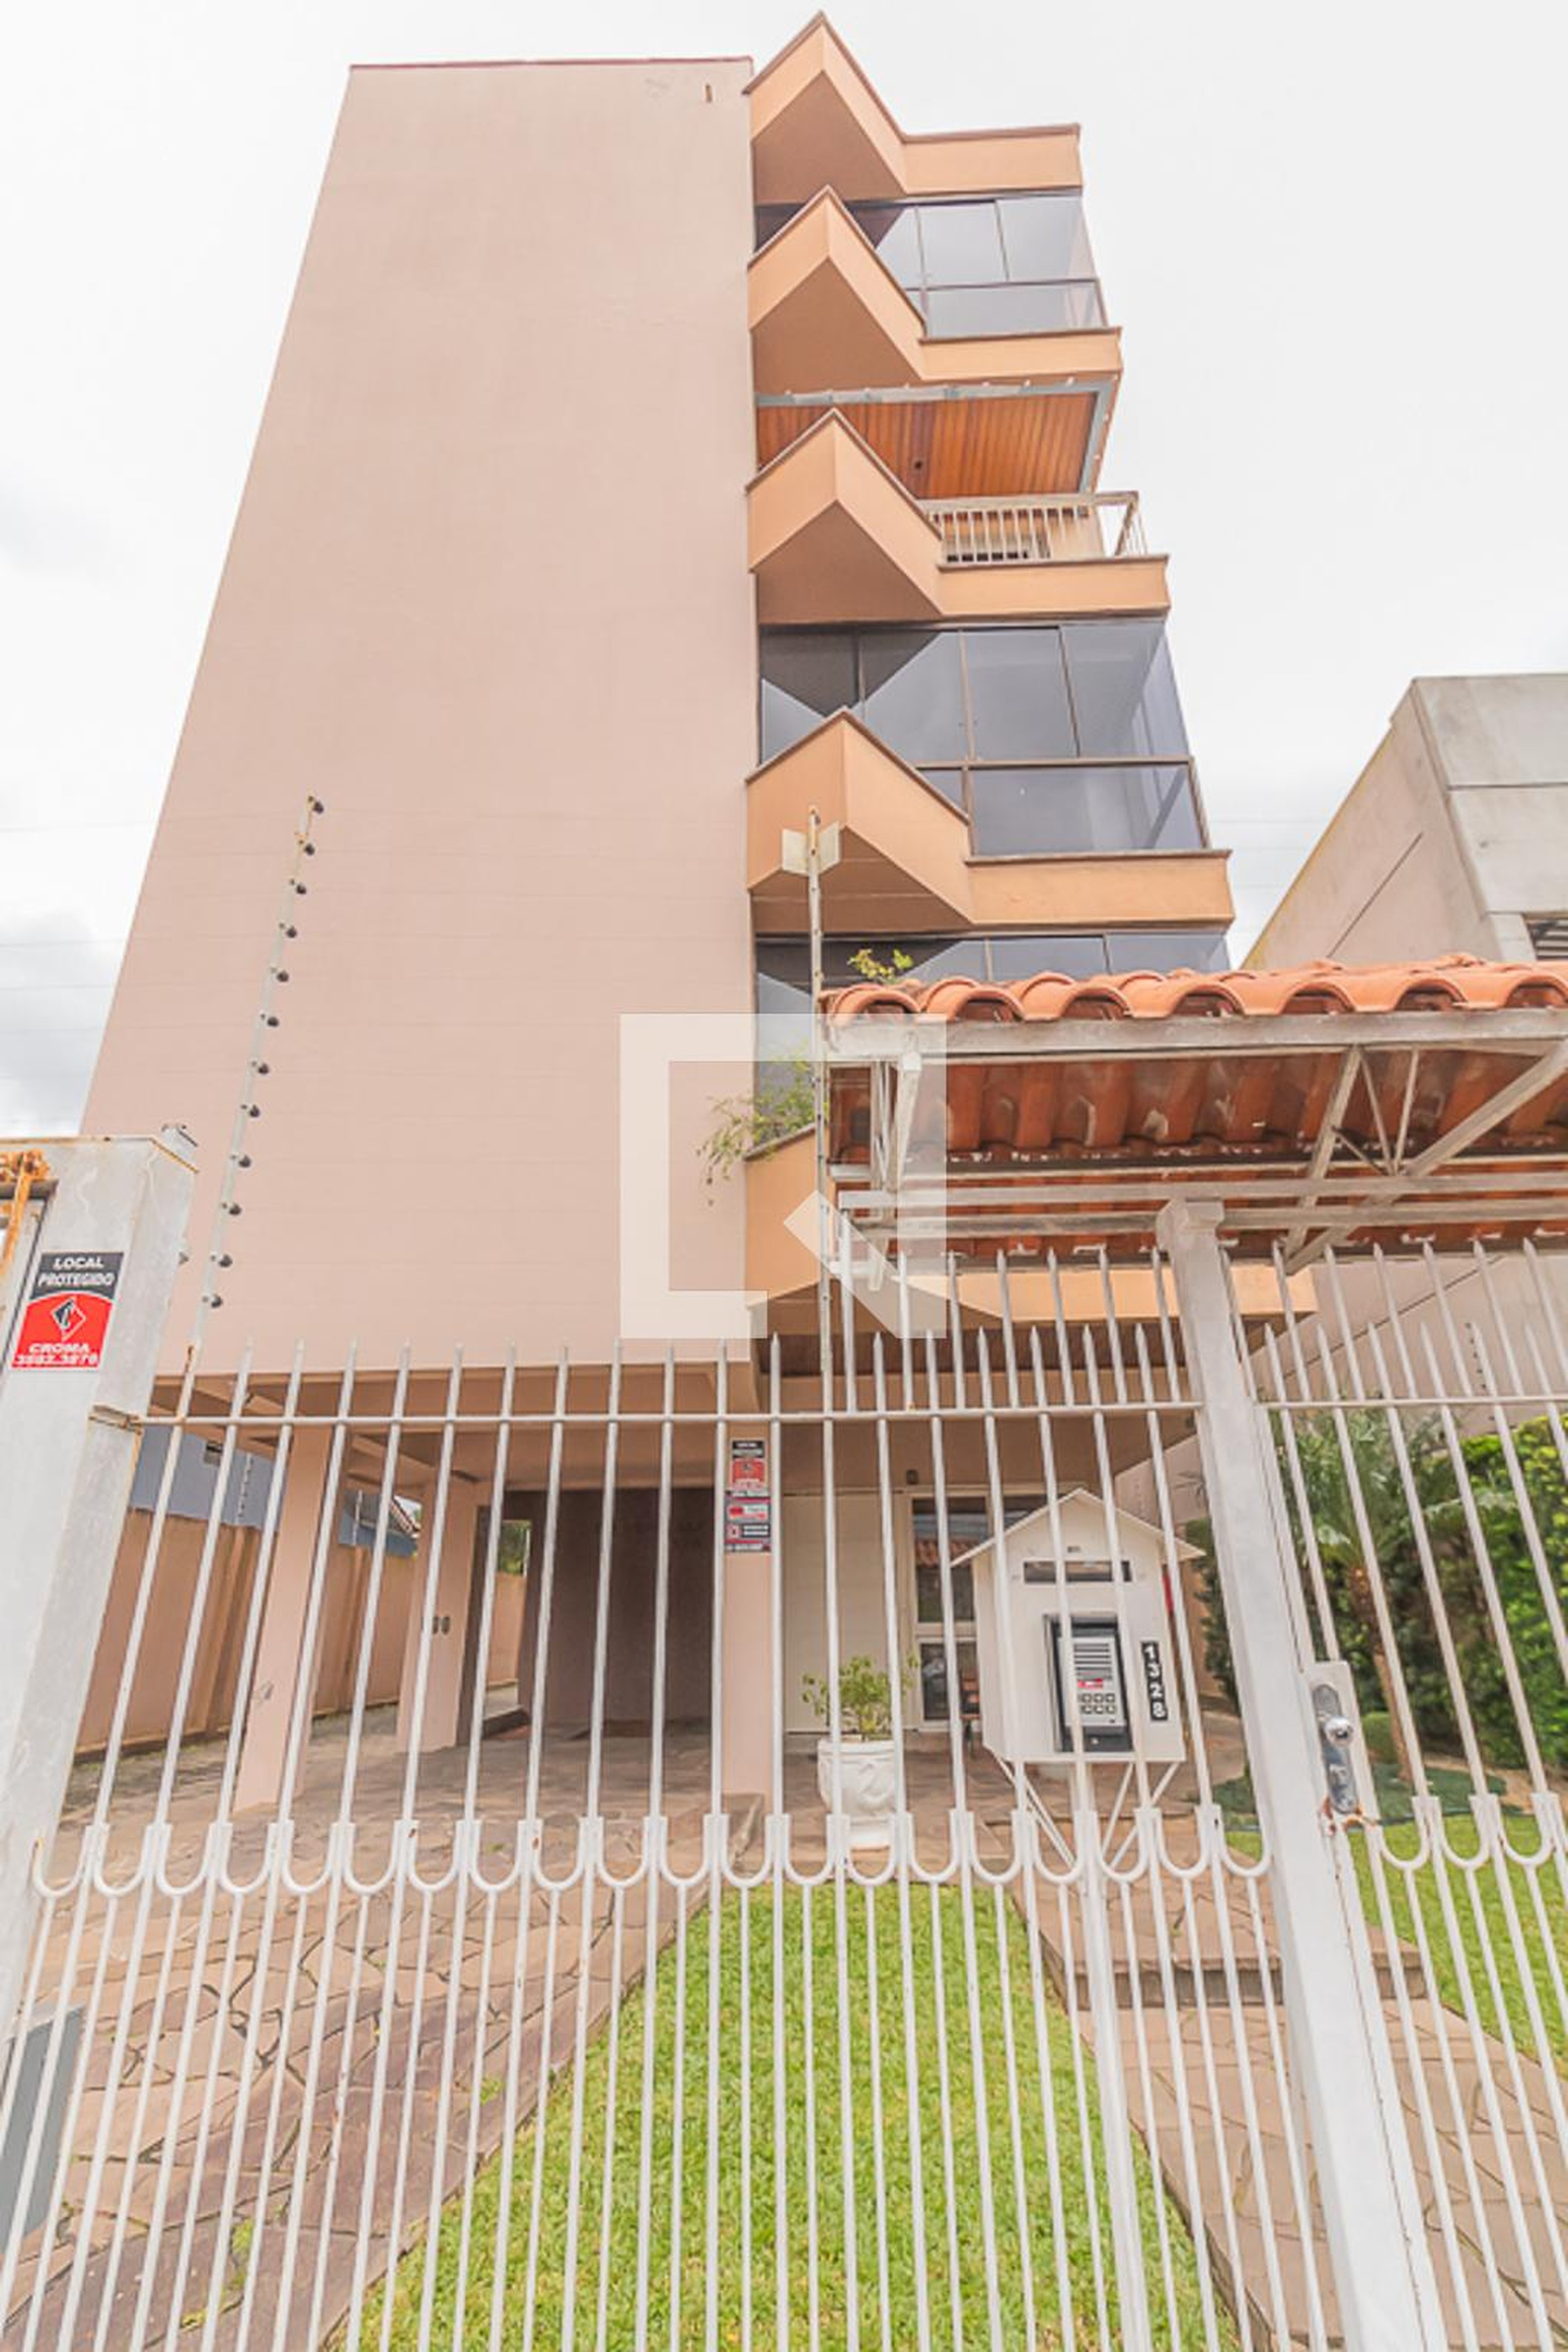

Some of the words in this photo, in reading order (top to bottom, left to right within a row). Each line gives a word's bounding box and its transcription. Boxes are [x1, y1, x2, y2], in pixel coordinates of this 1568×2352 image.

[53, 1256, 104, 1270] LOCAL
[38, 1272, 115, 1287] PROTEGIDO
[29, 1343, 90, 1354] CROMA
[1144, 1645, 1166, 1717] 1328
